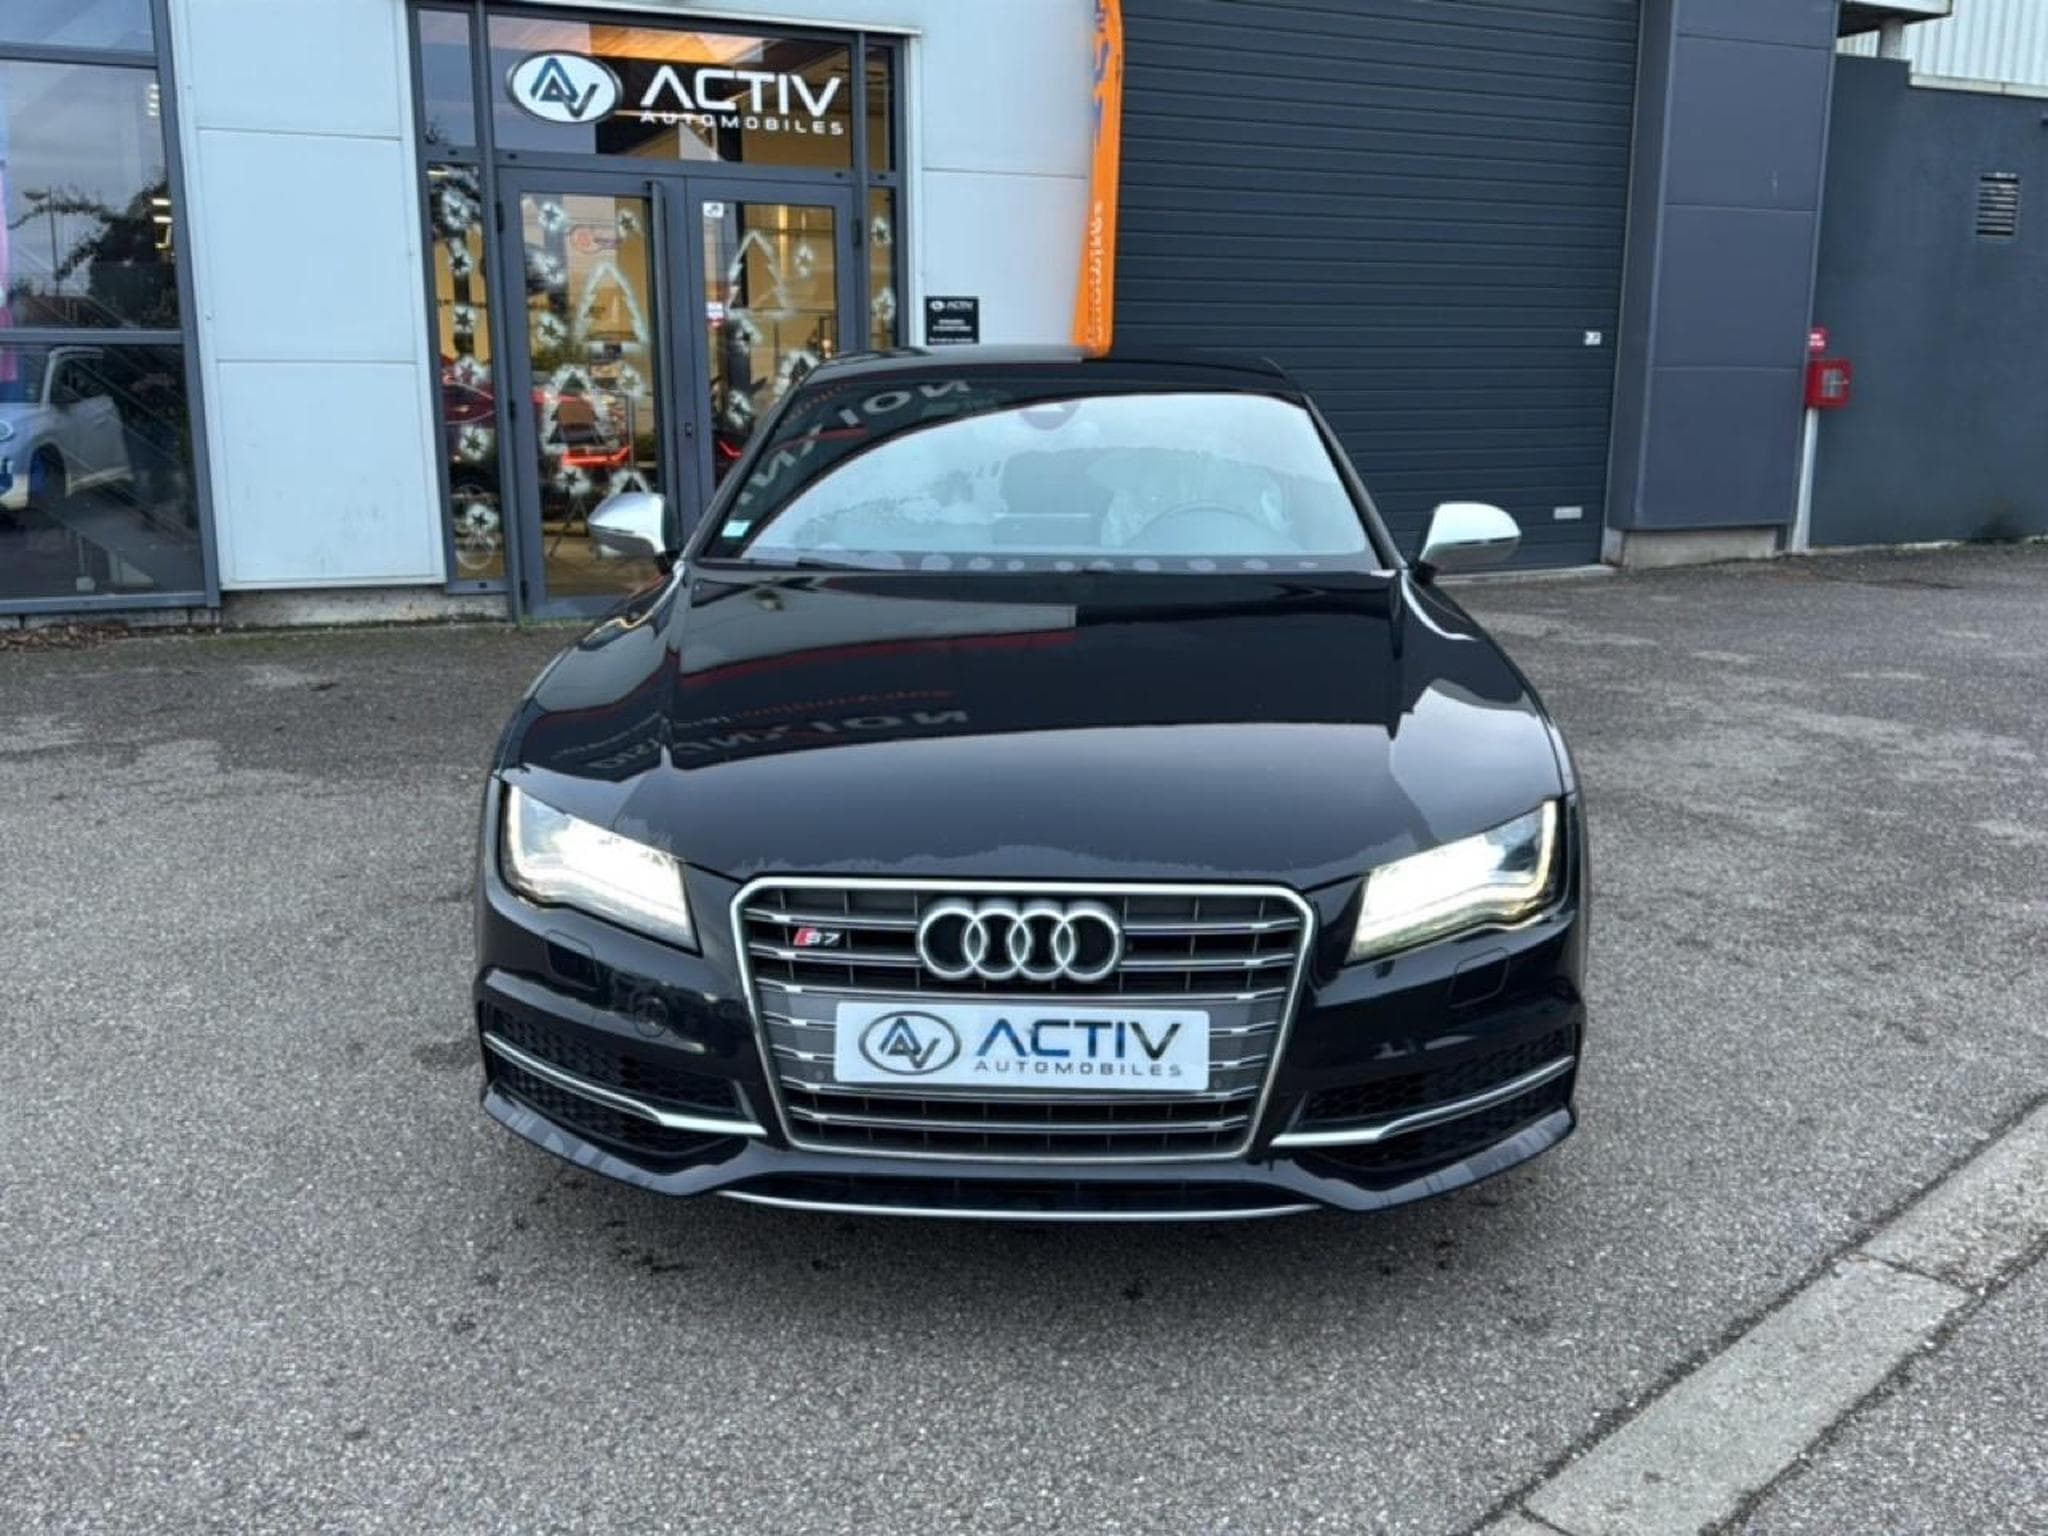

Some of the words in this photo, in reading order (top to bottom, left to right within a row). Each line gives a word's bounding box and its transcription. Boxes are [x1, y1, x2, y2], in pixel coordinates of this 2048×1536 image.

[639, 64, 842, 117] ACTIV
[639, 110, 845, 136] AUTOMOBILES
[804, 930, 840, 947] S7
[975, 1017, 1183, 1061] ACTIV
[973, 1060, 1184, 1077] AUTOMOBILES
